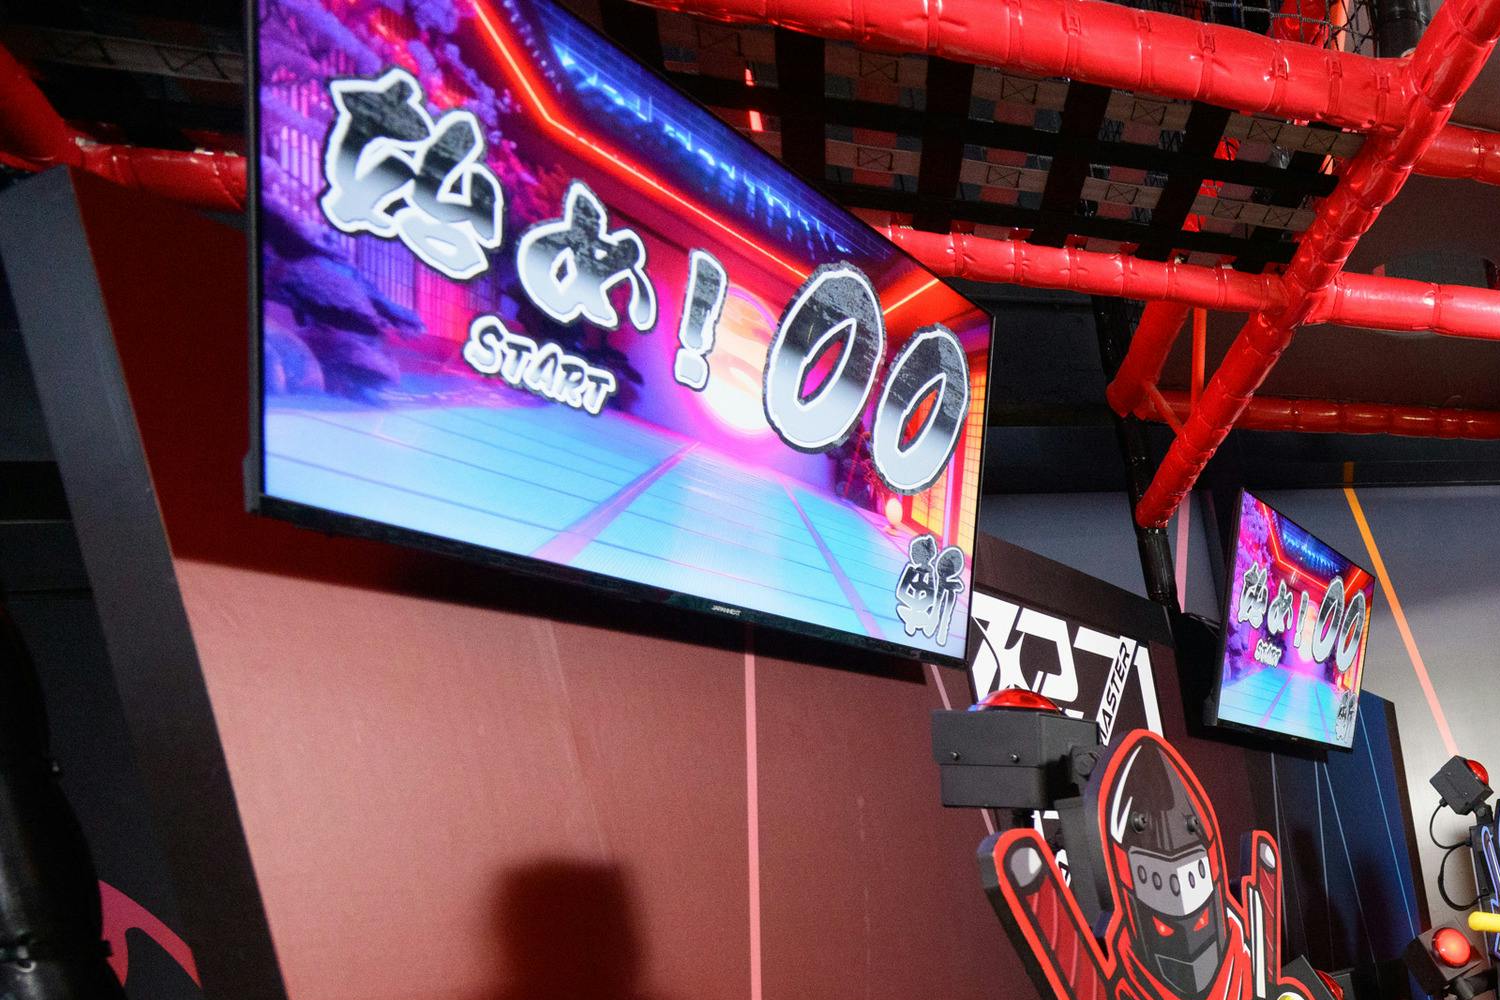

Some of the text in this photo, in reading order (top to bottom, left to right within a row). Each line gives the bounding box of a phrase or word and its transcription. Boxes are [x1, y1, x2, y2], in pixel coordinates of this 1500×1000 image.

[464, 315, 616, 415] START
[763, 262, 970, 495] 00
[1254, 639, 1282, 668] START
[1312, 576, 1366, 672] 00
